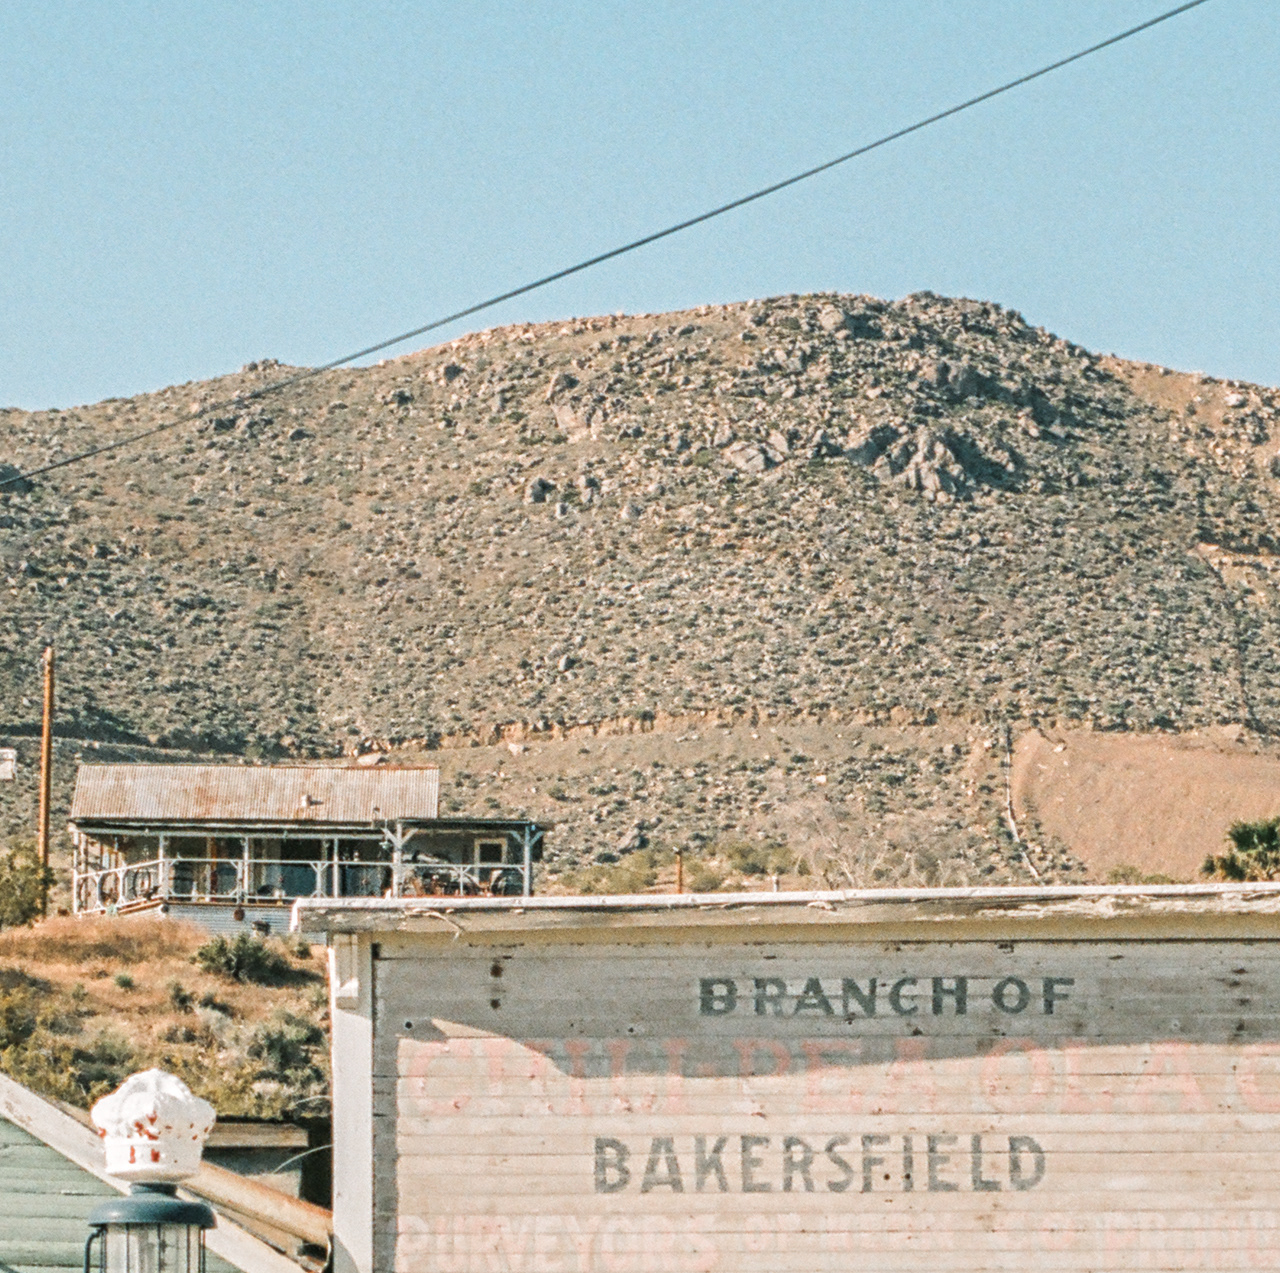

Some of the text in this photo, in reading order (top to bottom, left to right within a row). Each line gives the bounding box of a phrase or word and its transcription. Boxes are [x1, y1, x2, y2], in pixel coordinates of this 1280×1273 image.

[699, 976, 1076, 1016] BRANCH OF
[594, 1134, 1047, 1195] BAKERSFIELD
